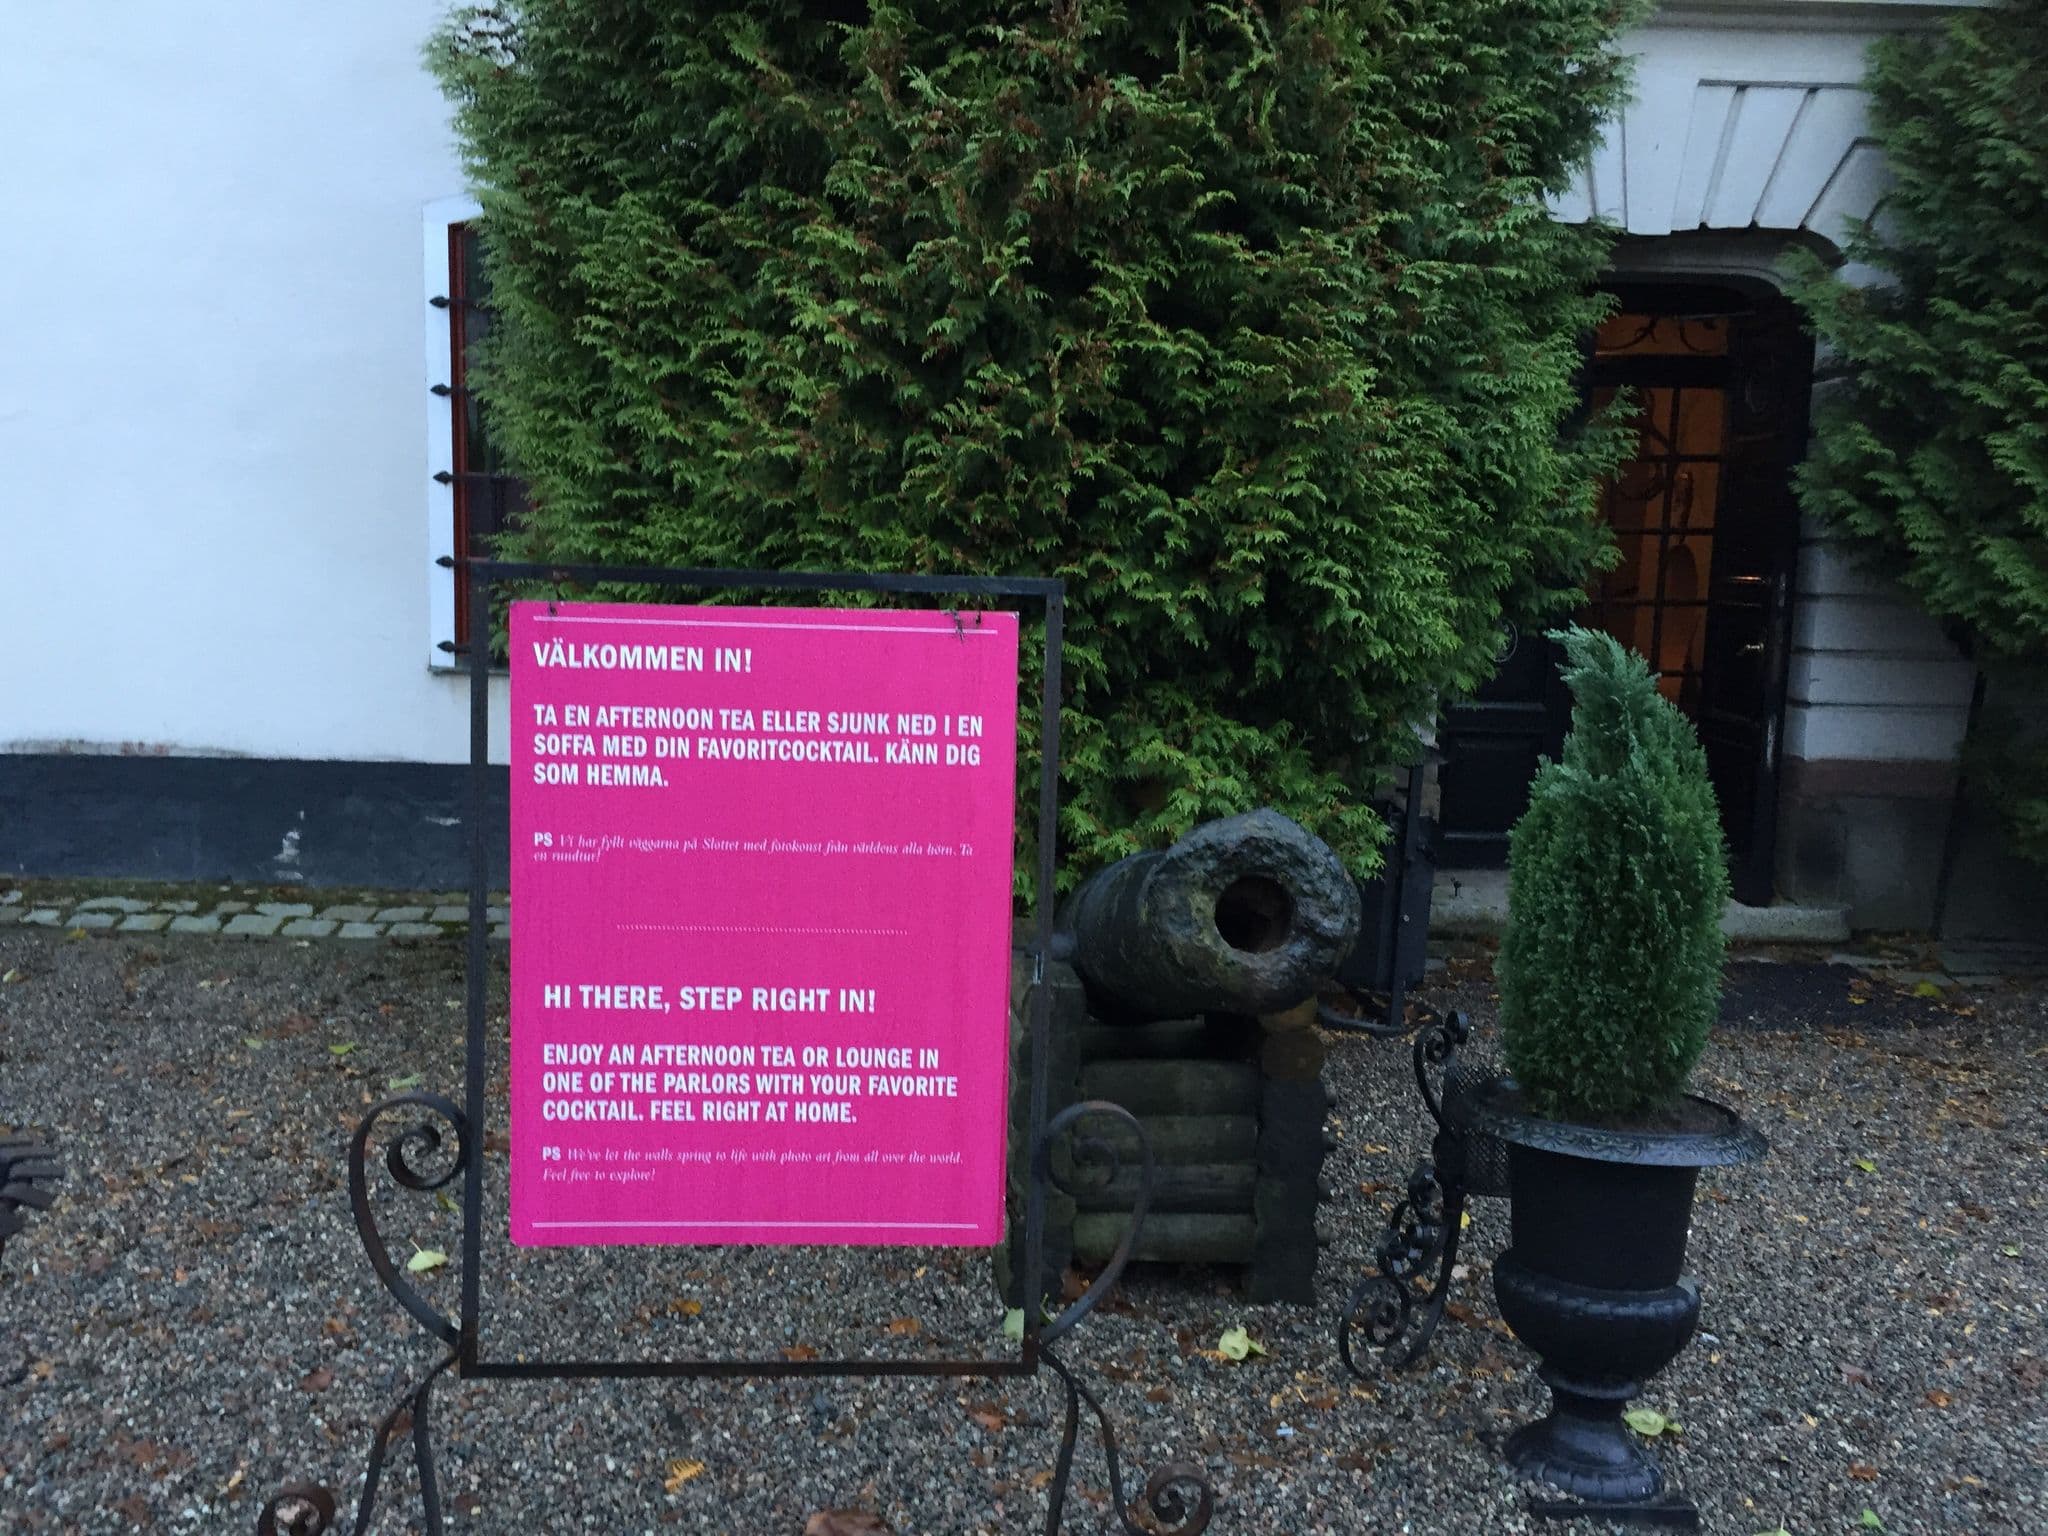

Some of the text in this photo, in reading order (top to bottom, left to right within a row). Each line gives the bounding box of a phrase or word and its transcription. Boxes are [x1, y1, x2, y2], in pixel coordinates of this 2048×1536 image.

[533, 637, 752, 673] VÄLKOMMEN IN!
[533, 704, 983, 737] TA EN AFTERNOON TEA ELLER SJUNK NED I EN
[533, 733, 981, 767] SOFFA MED DIN FAVORITCOCKTAIL. KÄNN DIG
[533, 763, 669, 787] SOM HEMMA.
[533, 832, 553, 847] PS
[743, 839, 767, 852] med
[902, 841, 923, 855] alla
[959, 843, 974, 857] Ta
[543, 985, 876, 1014] HI THERE, STEP RIGHT IN!
[543, 1044, 939, 1069] ENJOY AN AFTERNOON TEA OR LOUNGE IN
[543, 1072, 958, 1098] ONE OF THE PARLORS WITH YOUR FAVORITE
[543, 1100, 857, 1124] COCKTAIL. FEEL RIGHT AT HOME.
[542, 1146, 561, 1161] PS
[605, 1147, 619, 1161] let
[623, 1148, 641, 1161] the
[645, 1148, 673, 1162] walls
[676, 1149, 712, 1164] spring
[715, 1150, 727, 1161] to
[730, 1148, 748, 1165] life
[751, 1148, 777, 1162] with
[780, 1149, 812, 1166] photo
[815, 1151, 831, 1163] art
[831, 1150, 860, 1166] from
[864, 1150, 879, 1163] all
[882, 1152, 905, 1163] over
[908, 1150, 926, 1163] the
[542, 1168, 567, 1181] Feel
[567, 1168, 591, 1185] free
[594, 1170, 606, 1181] to
